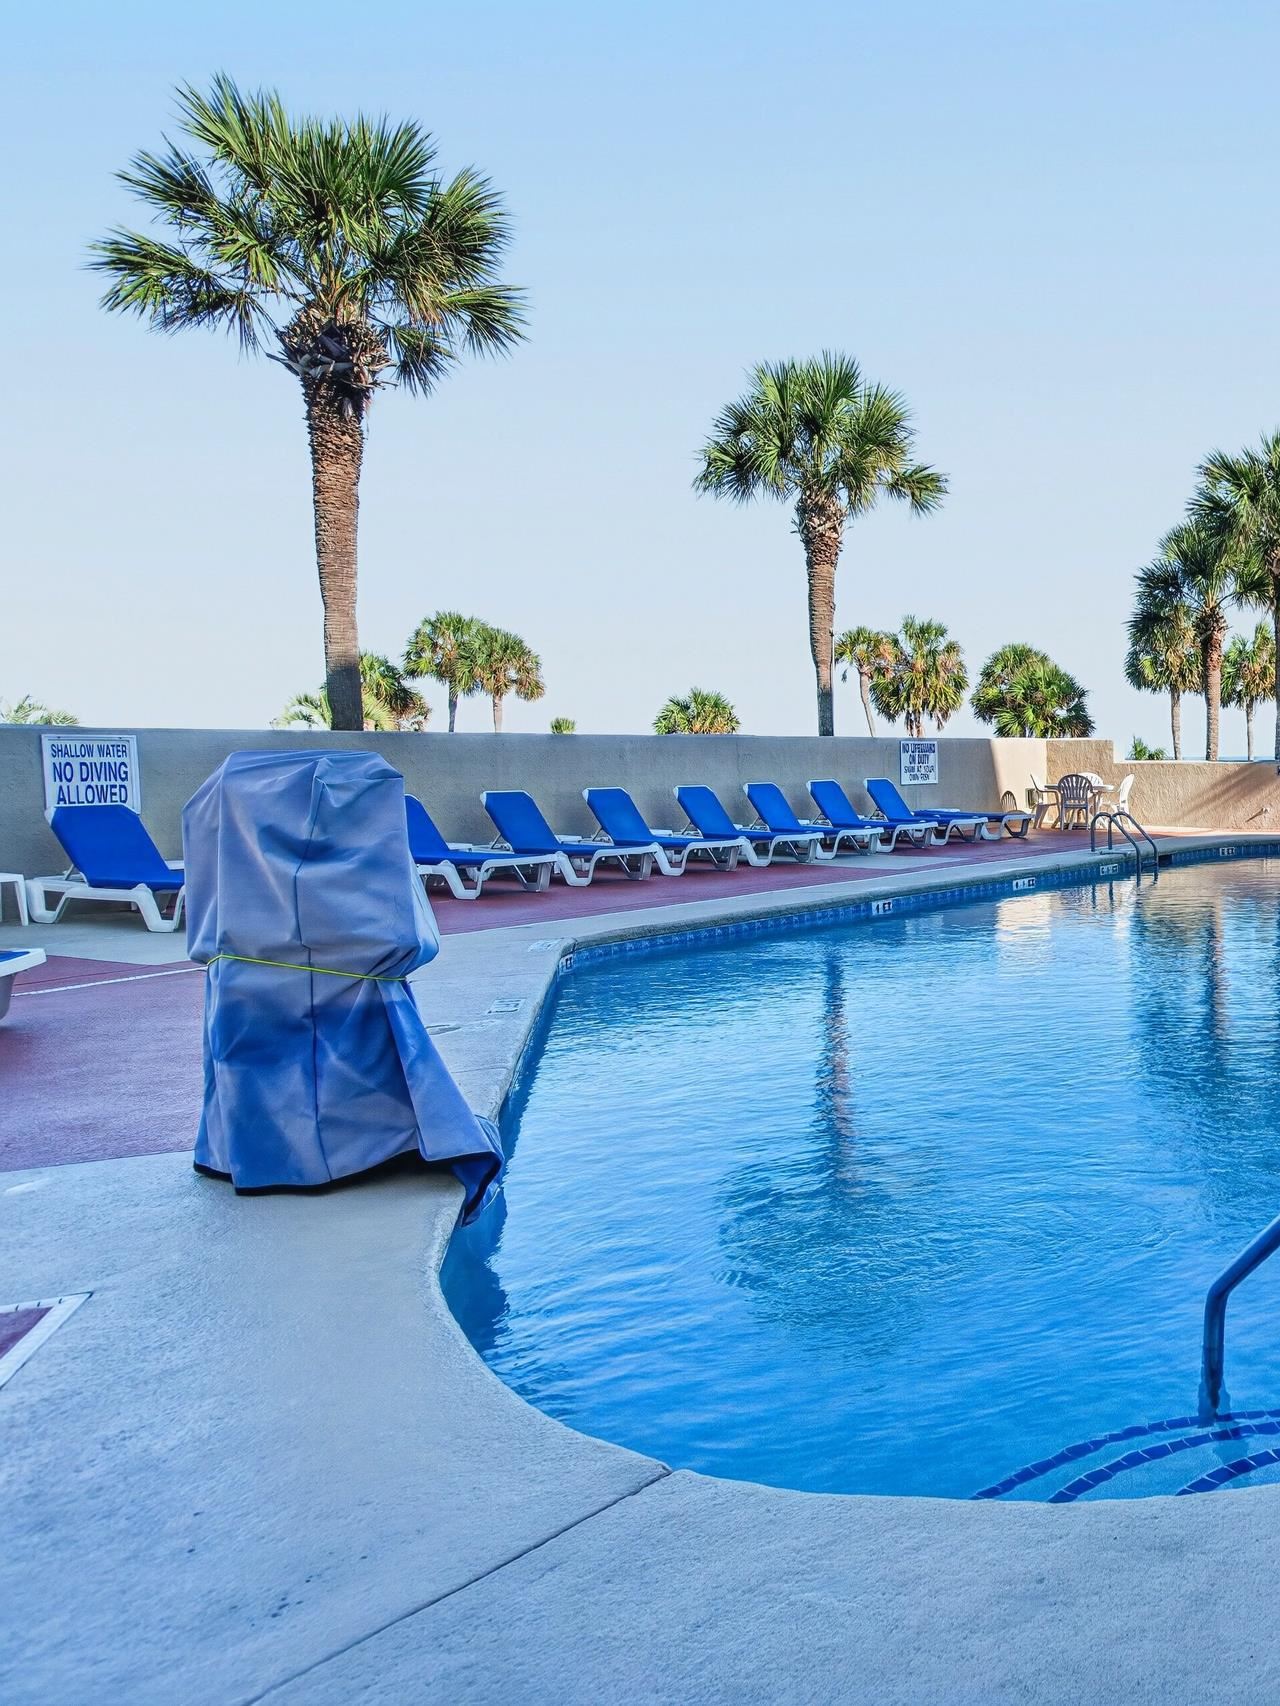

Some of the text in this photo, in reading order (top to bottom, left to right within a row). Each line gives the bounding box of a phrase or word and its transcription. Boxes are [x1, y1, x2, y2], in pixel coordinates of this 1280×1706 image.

[51, 743, 128, 758] SHALLOW WATER
[53, 761, 129, 782] NO DIVING
[57, 784, 128, 805] ALLOWED
